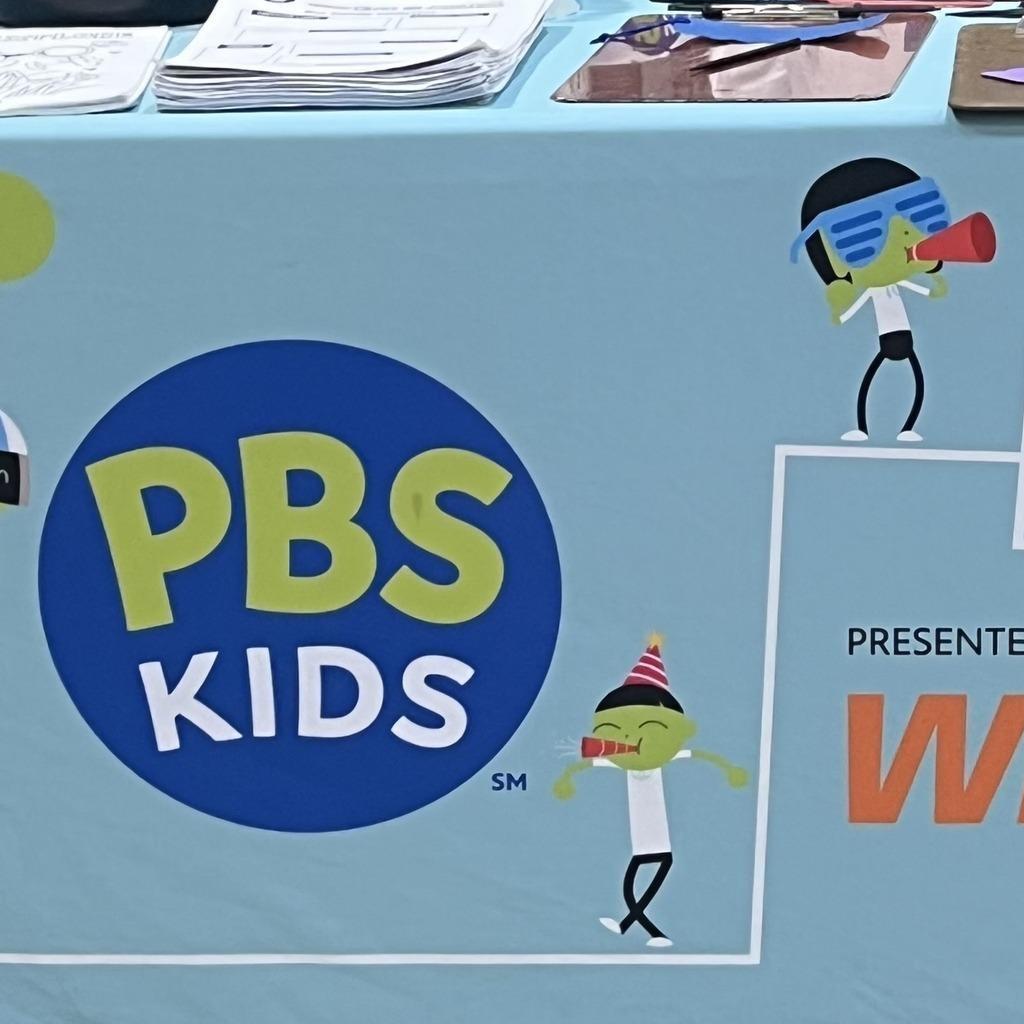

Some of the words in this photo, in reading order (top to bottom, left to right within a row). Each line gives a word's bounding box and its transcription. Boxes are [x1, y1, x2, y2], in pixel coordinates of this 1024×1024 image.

[85, 430, 513, 632] PBS
[138, 646, 476, 753] KIDS
[491, 772, 527, 792] SM
